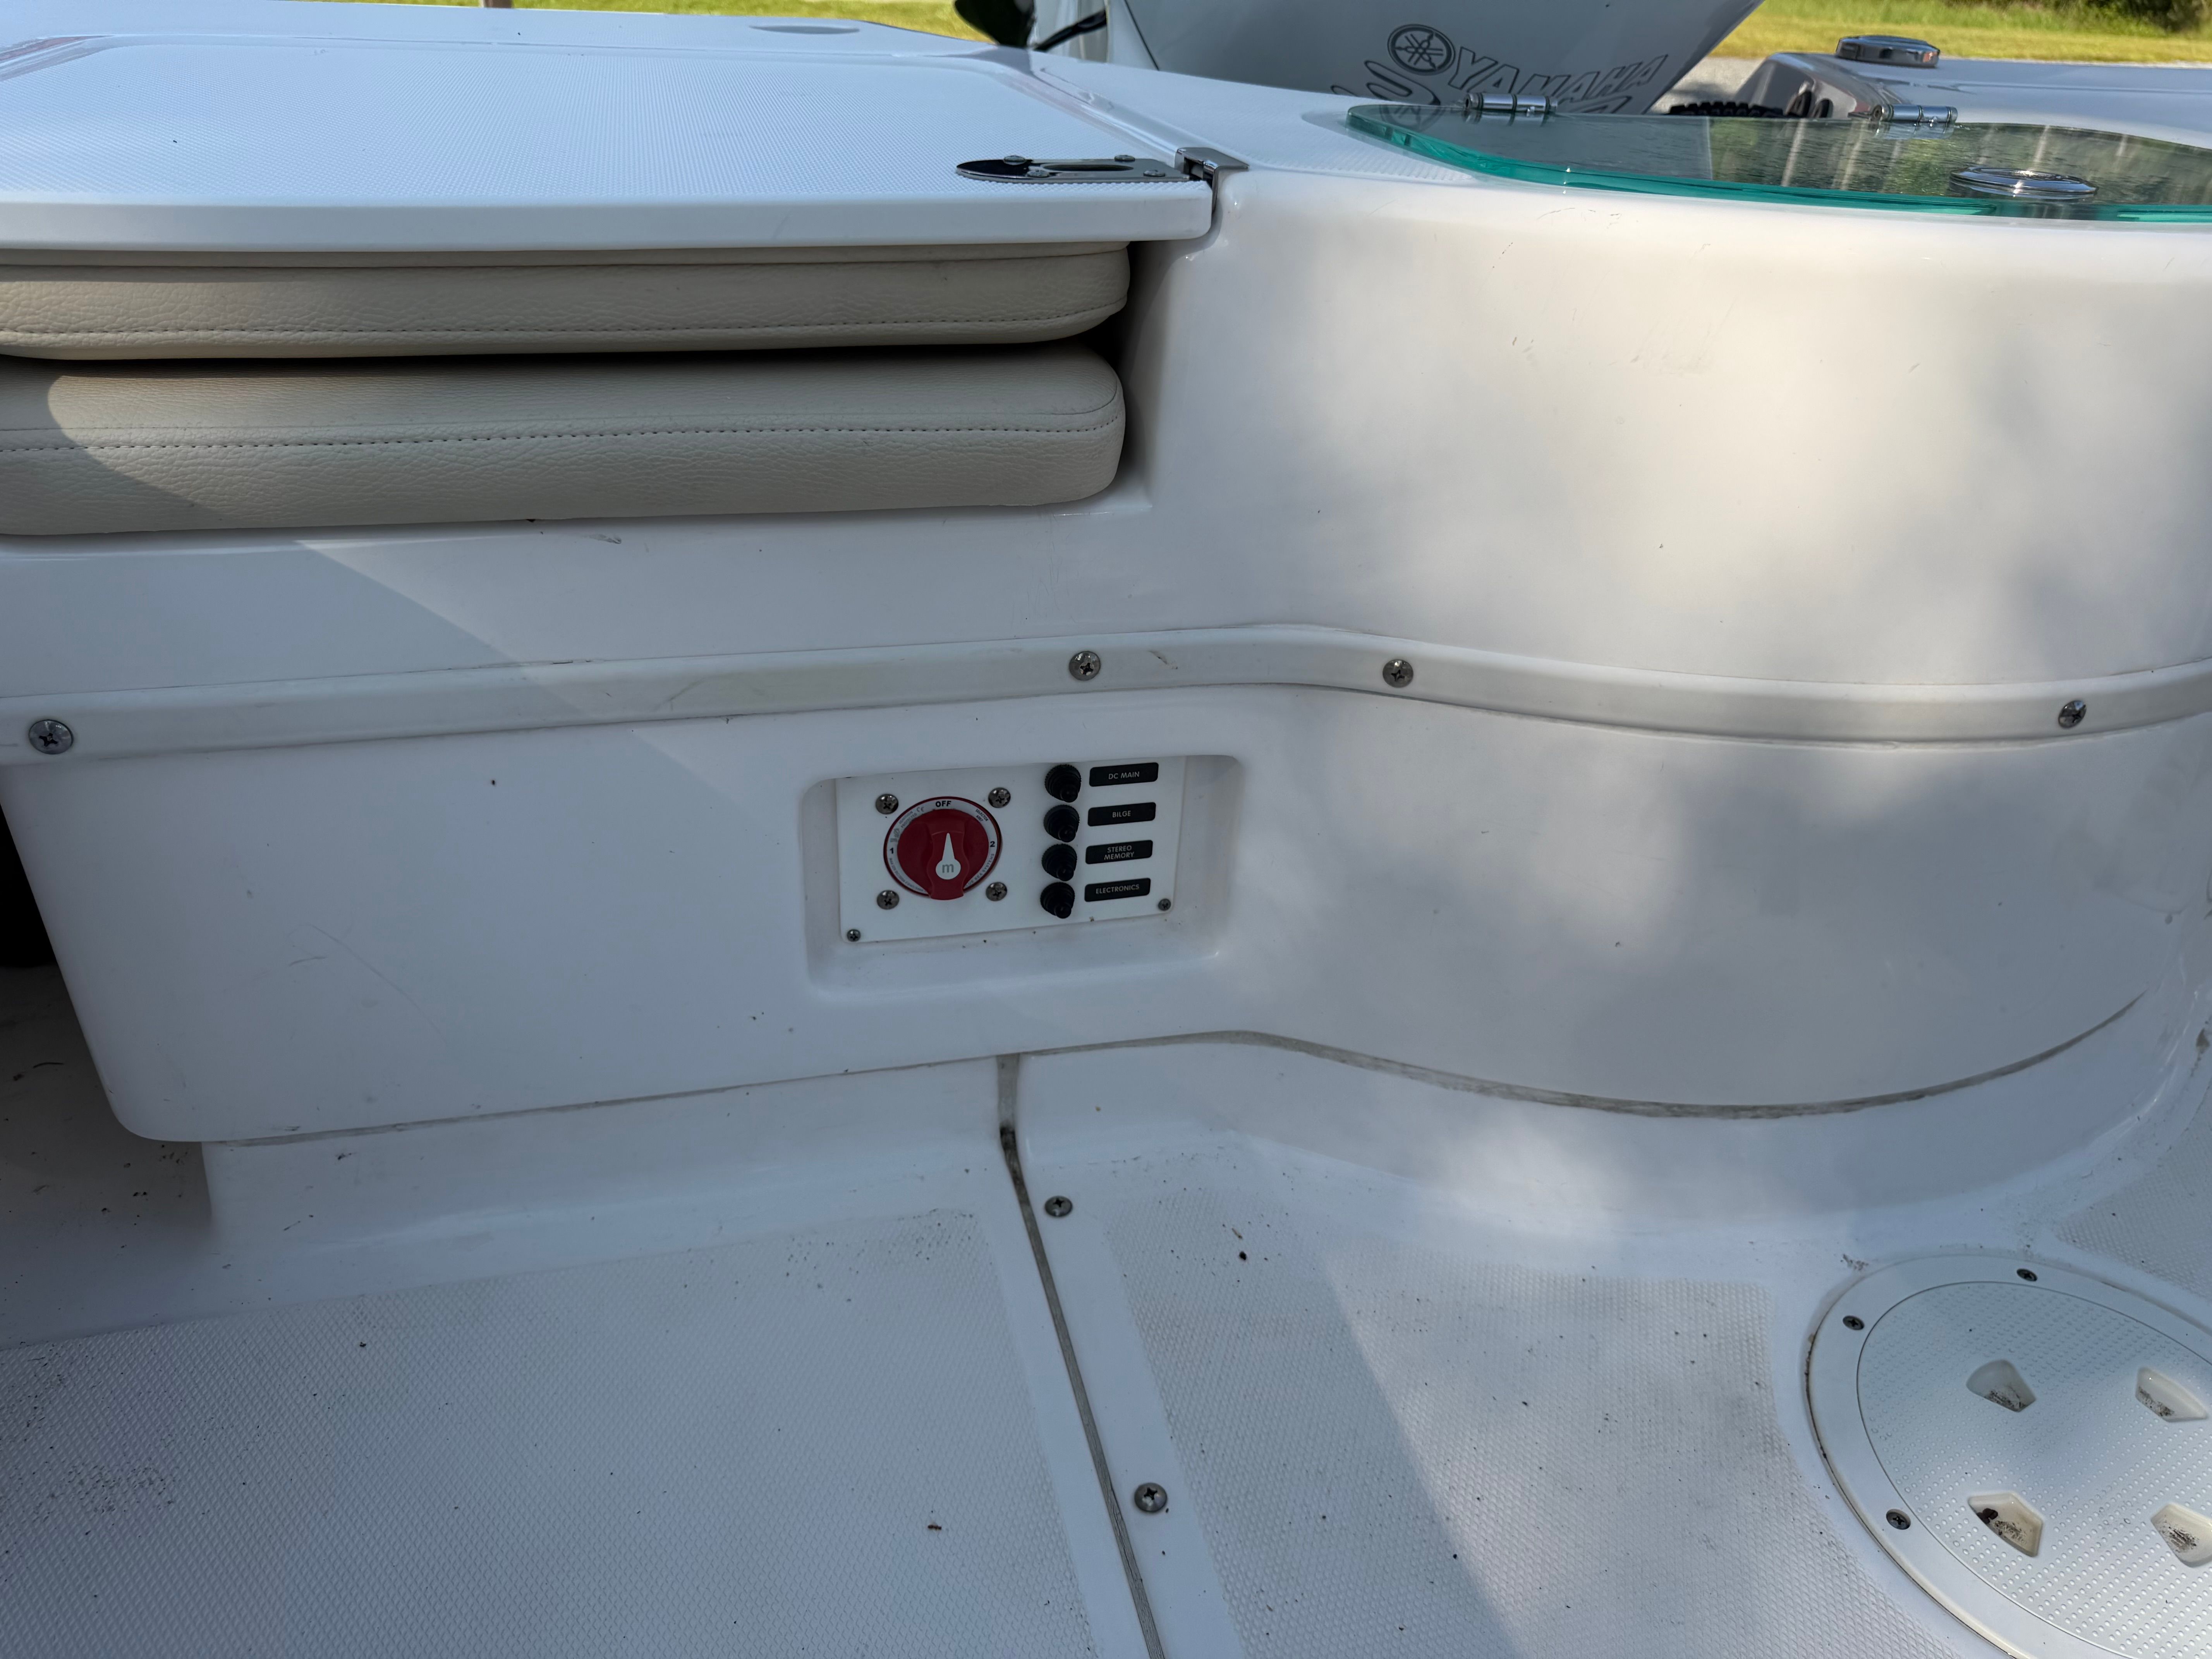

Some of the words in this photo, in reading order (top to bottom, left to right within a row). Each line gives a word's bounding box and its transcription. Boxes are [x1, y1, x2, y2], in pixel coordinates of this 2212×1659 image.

[1448, 46, 1669, 107] YAMAHA
[975, 809, 989, 821] SELECTOR
[1104, 852, 1134, 860] MEMORY
[942, 864, 954, 873] m
[1096, 884, 1140, 894] ELECTRONICS
